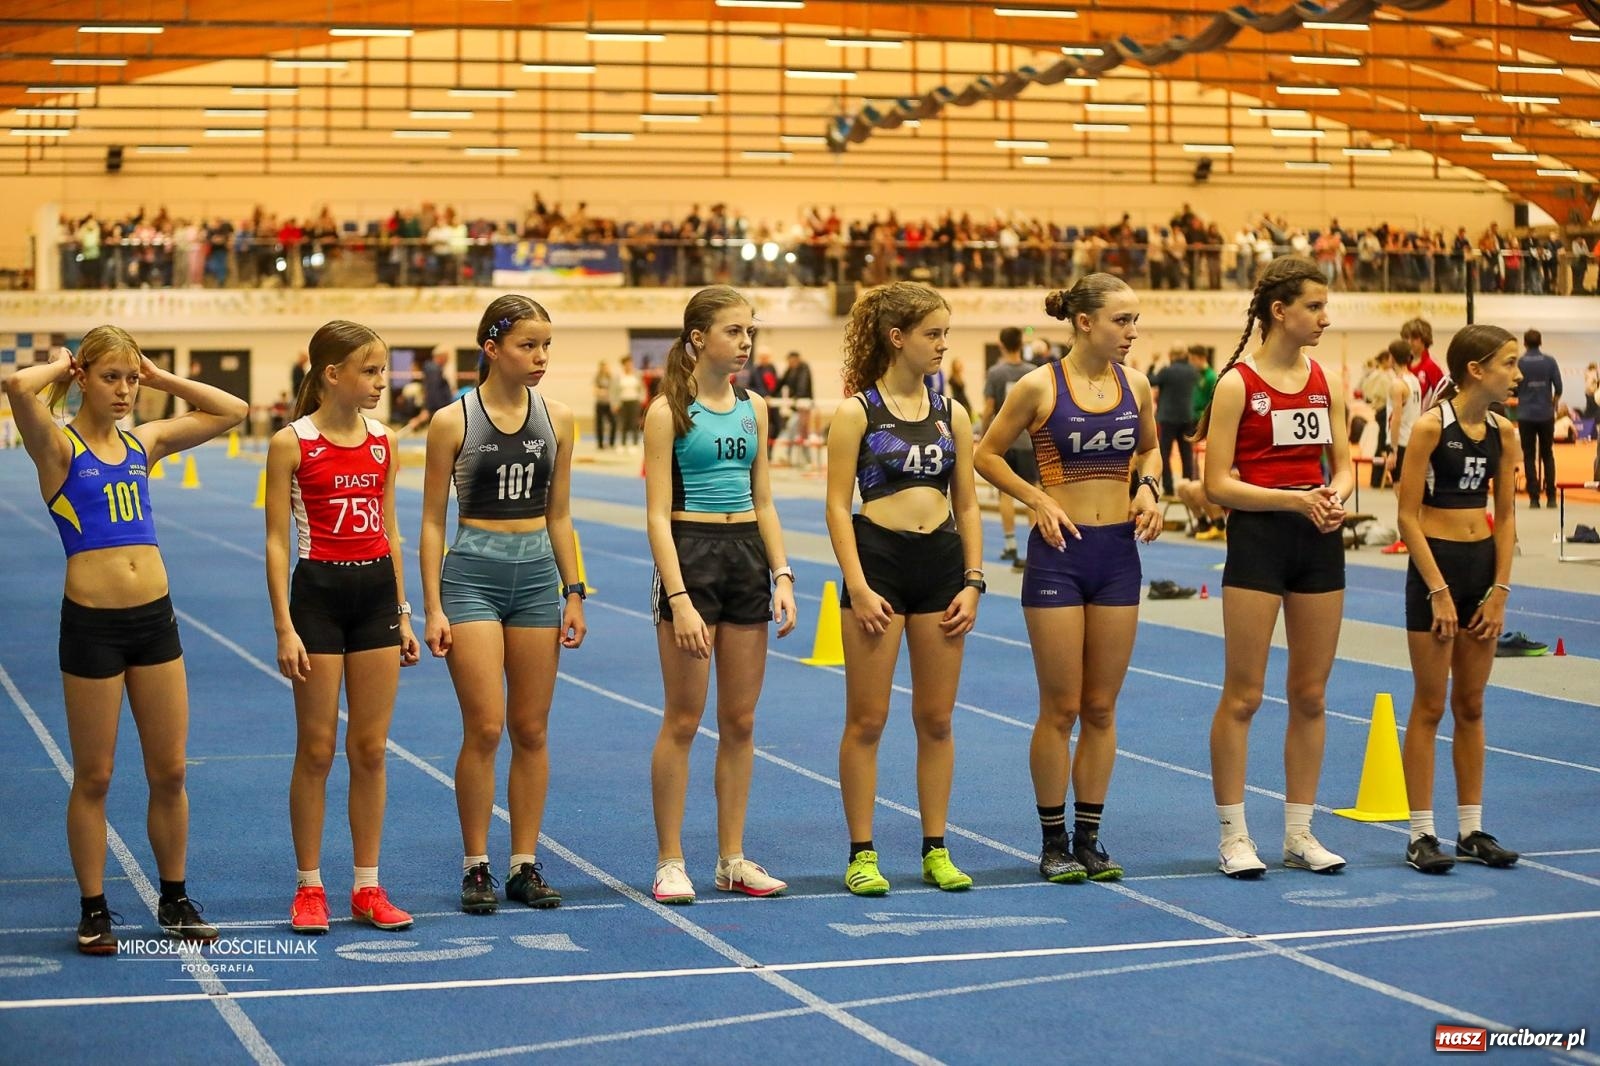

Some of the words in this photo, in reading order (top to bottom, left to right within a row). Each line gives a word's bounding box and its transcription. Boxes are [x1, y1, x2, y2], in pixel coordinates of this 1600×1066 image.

[1293, 412, 1320, 440] 39
[478, 443, 500, 453] esa
[714, 437, 747, 461] 136
[1068, 428, 1136, 453] 146
[78, 468, 100, 478] esa
[903, 443, 944, 476] 43
[1459, 456, 1488, 490] 55
[334, 474, 379, 489] PIAST
[496, 462, 535, 500] 101
[103, 481, 144, 523] 101
[329, 497, 380, 535] 758
